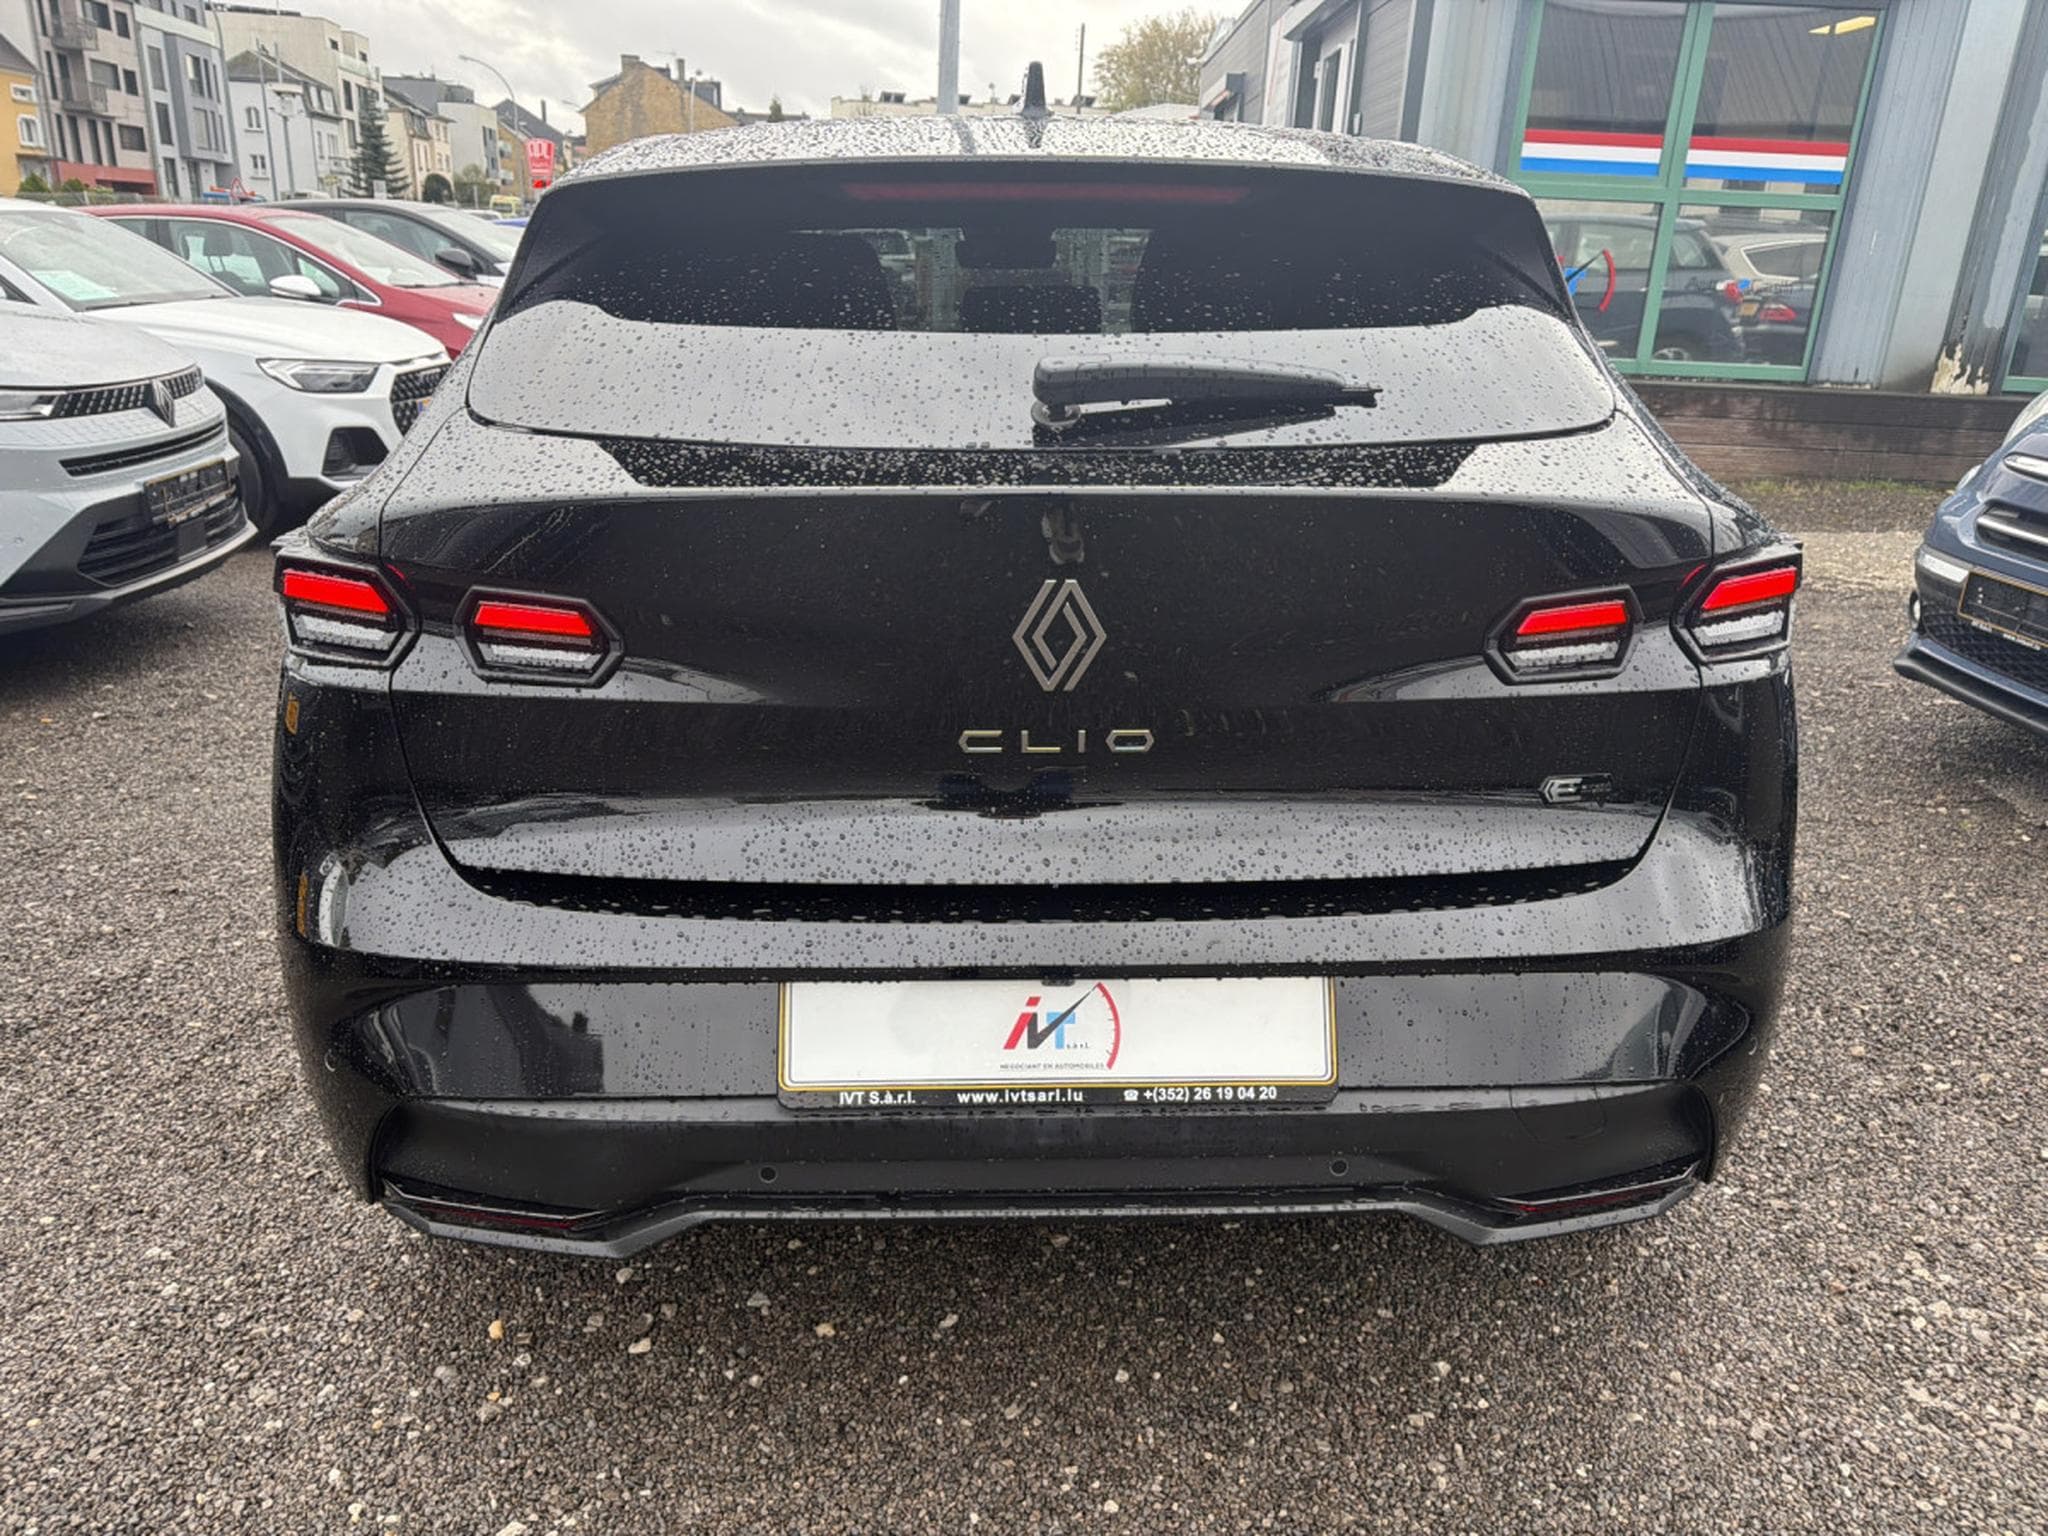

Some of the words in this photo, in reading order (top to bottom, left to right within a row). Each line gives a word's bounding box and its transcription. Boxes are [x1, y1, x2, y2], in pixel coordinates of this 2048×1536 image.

[958, 729, 1154, 753] CLIO
[839, 1091, 865, 1105] IVT
[869, 1090, 916, 1105] S.à.r.l.
[957, 1088, 1083, 1103] www.ivtsarl.lu
[1143, 1086, 1190, 1103] +(352)
[1194, 1087, 1212, 1100] 26
[1216, 1086, 1233, 1100] 19
[1237, 1086, 1255, 1100] 04
[1259, 1085, 1277, 1100] 20
